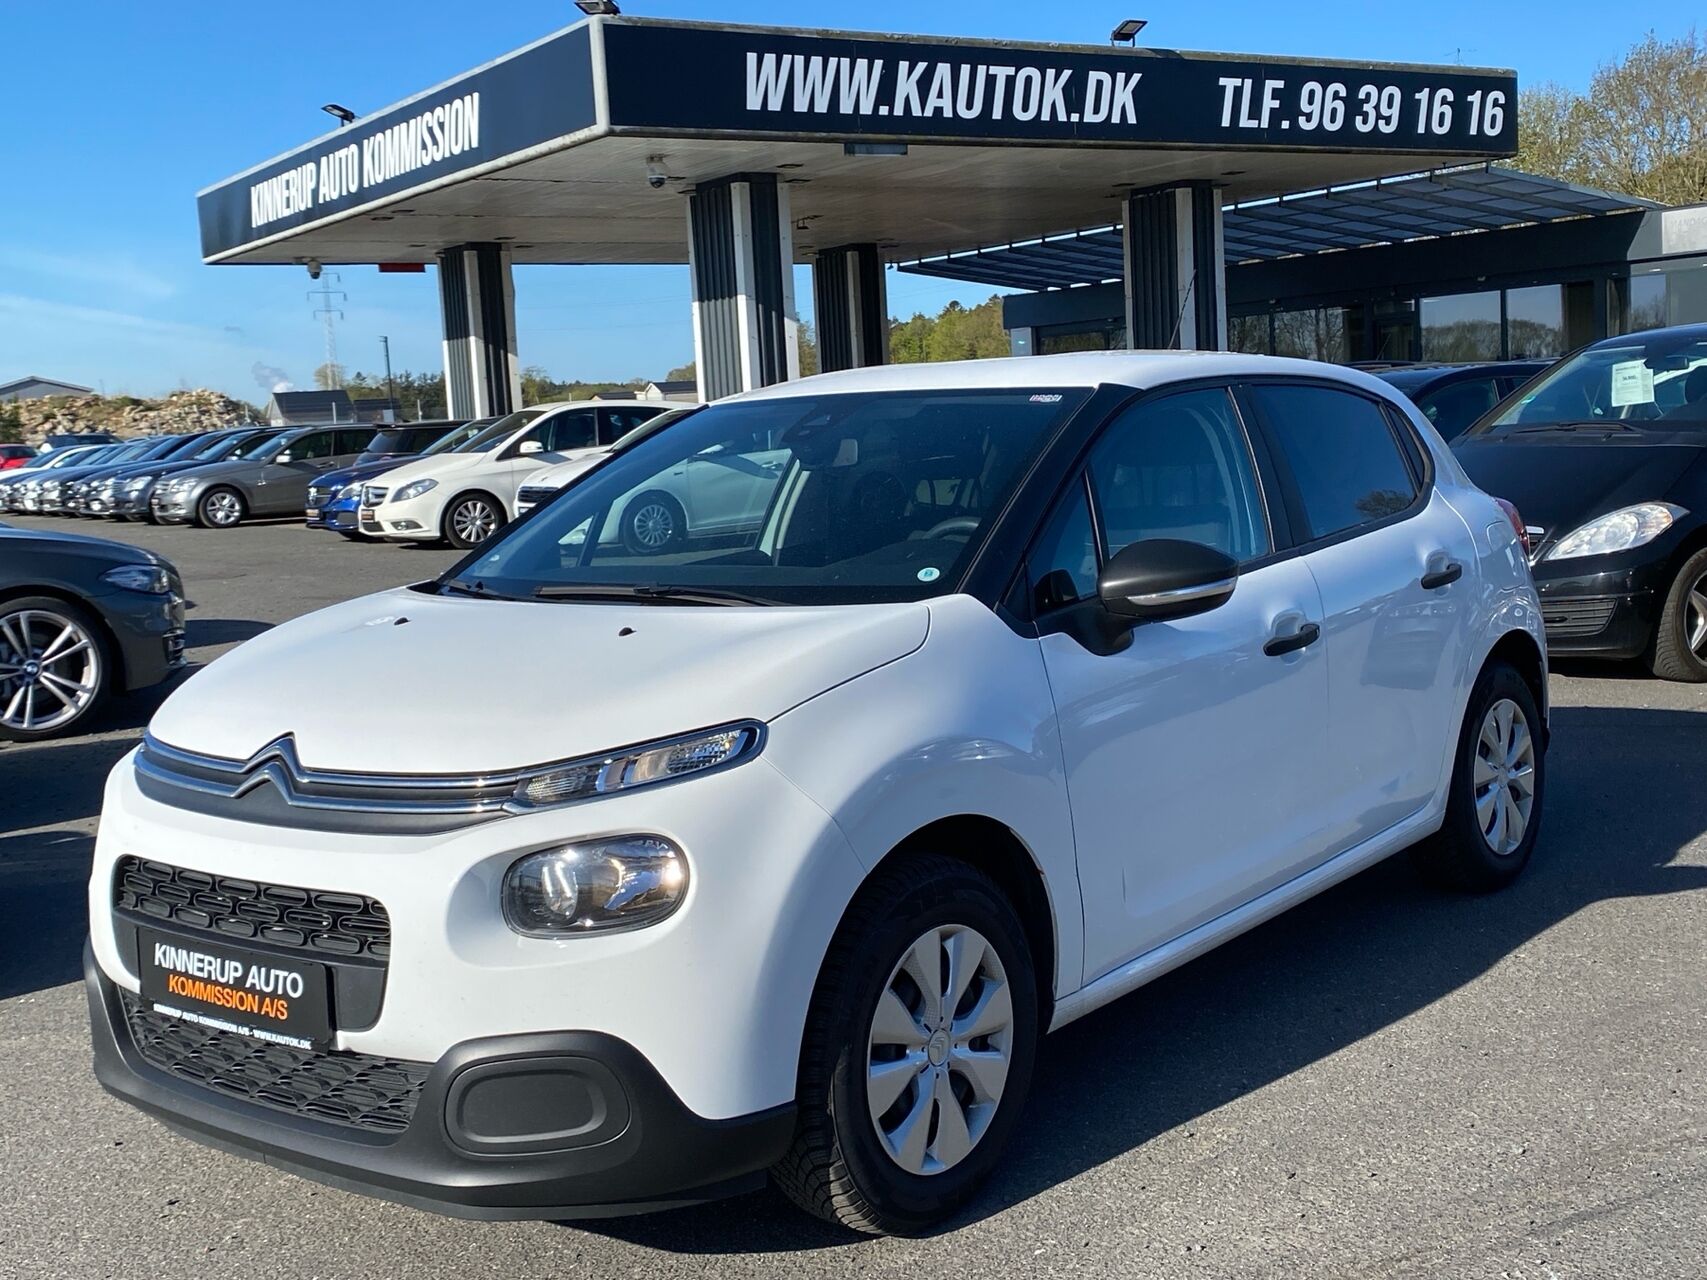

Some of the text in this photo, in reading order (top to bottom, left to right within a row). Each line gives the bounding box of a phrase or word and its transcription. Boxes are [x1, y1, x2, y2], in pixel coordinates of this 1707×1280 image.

[745, 51, 1143, 124] WWW.KAUTOK.DK
[1218, 77, 1506, 136] TLF. 96 39 16 16
[250, 92, 480, 228] KINNERUP AUTO KOMMISSION
[154, 942, 304, 999] KINNERUP AUTO
[168, 974, 288, 1021] KOMMISSION A/S
[181, 1011, 199, 1023] AUTO
[199, 1015, 238, 1033] KOMMISSION
